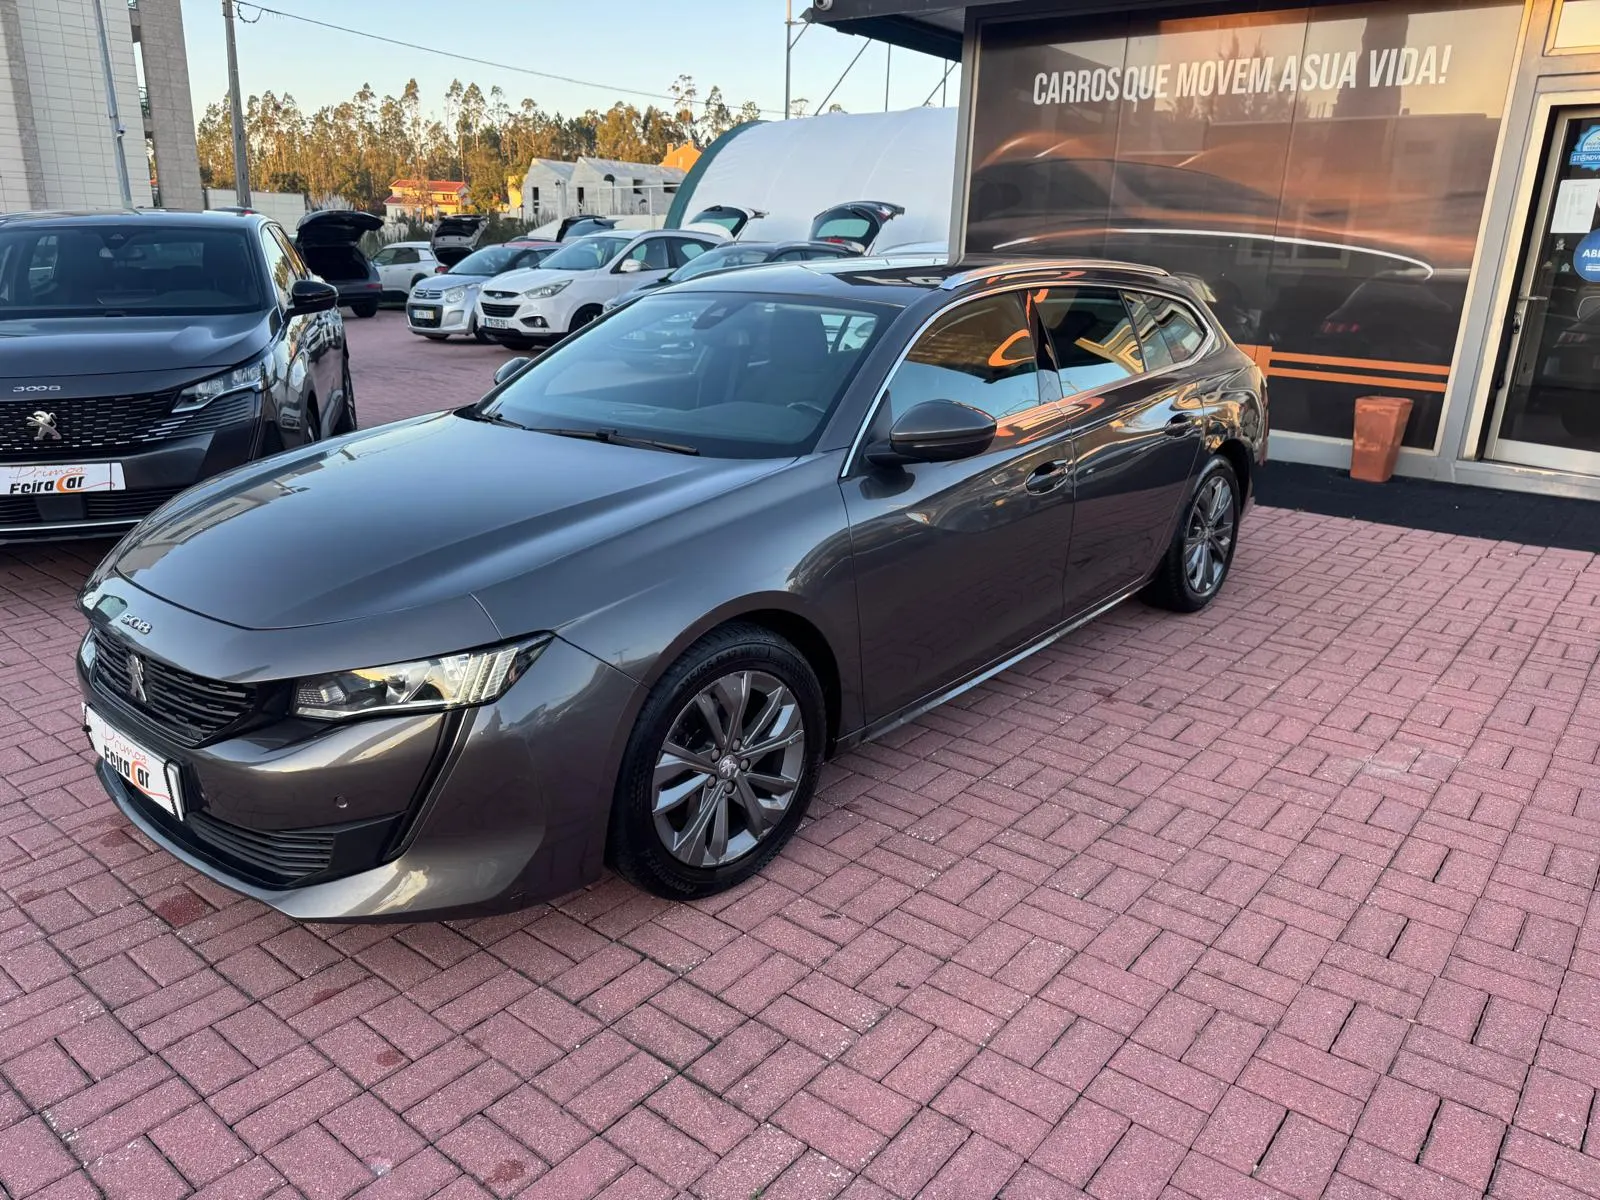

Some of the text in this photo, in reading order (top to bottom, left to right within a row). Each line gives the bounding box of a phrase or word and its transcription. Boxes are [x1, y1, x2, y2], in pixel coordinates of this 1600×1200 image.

[1033, 45, 1453, 112] CARROS QUE MOVEM A SUA VIDA!
[13, 385, 61, 393] 3008
[120, 612, 152, 635] 508
